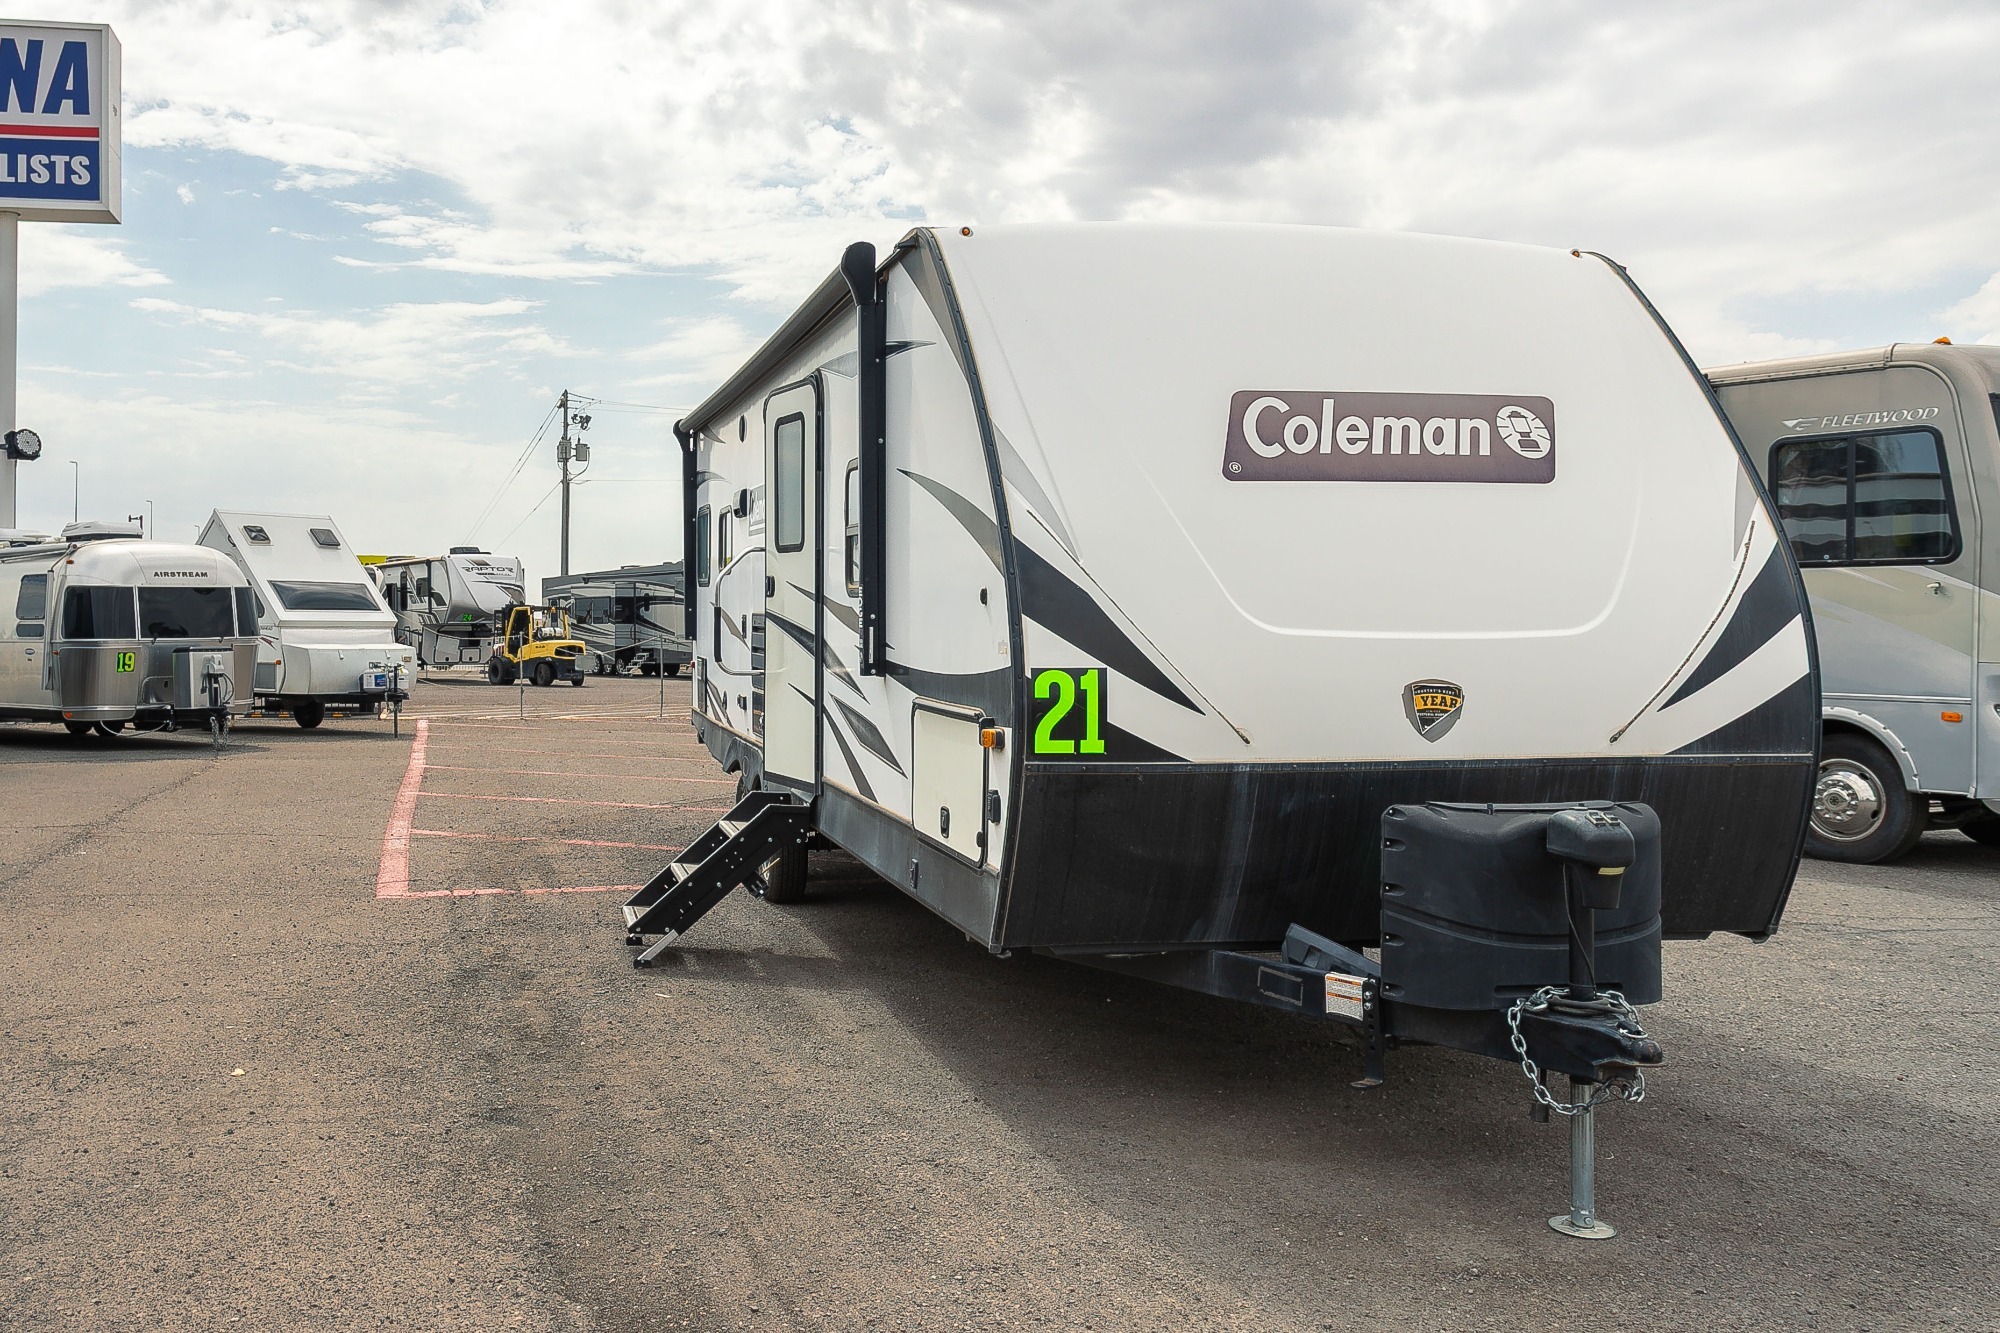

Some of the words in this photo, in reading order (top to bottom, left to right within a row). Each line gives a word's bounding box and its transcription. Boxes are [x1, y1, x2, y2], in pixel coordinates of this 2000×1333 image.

[0, 153, 91, 185] LISTS
[1241, 396, 1491, 459] Coleman
[1820, 407, 1939, 428] FLEETWOOD
[117, 652, 135, 672] 19
[1034, 669, 1105, 754] 21
[1420, 695, 1458, 708] YEAR
